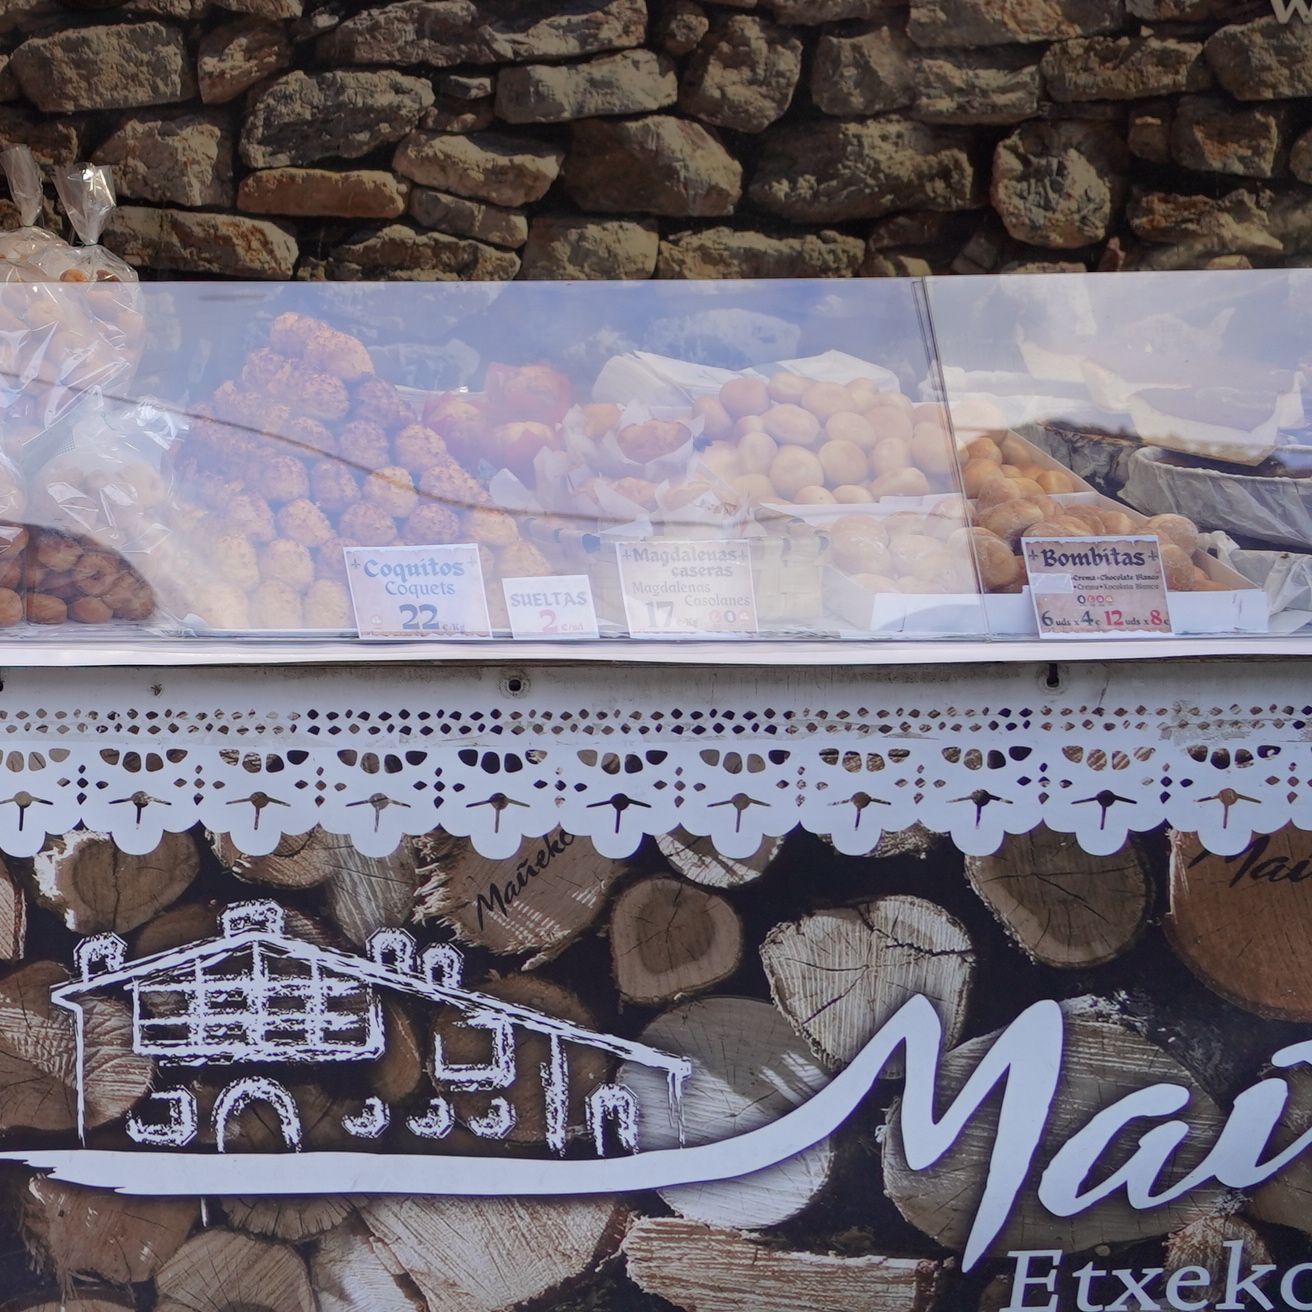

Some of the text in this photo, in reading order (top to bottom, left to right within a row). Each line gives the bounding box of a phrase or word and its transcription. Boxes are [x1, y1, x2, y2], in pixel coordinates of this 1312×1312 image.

[632, 547, 737, 567] Magdalenas
[1041, 547, 1145, 567] Bombitas
[364, 558, 464, 582] Coquitos
[672, 565, 733, 577] caseras
[385, 581, 455, 598] Coquets
[633, 581, 711, 596] Magdalenas
[510, 591, 587, 607] SUELTAS
[685, 594, 751, 607] Casolanes
[399, 604, 439, 630] 22
[539, 609, 558, 633] 2
[646, 601, 674, 628] 17
[1041, 610, 1053, 626] 6
[1104, 610, 1124, 626] 12
